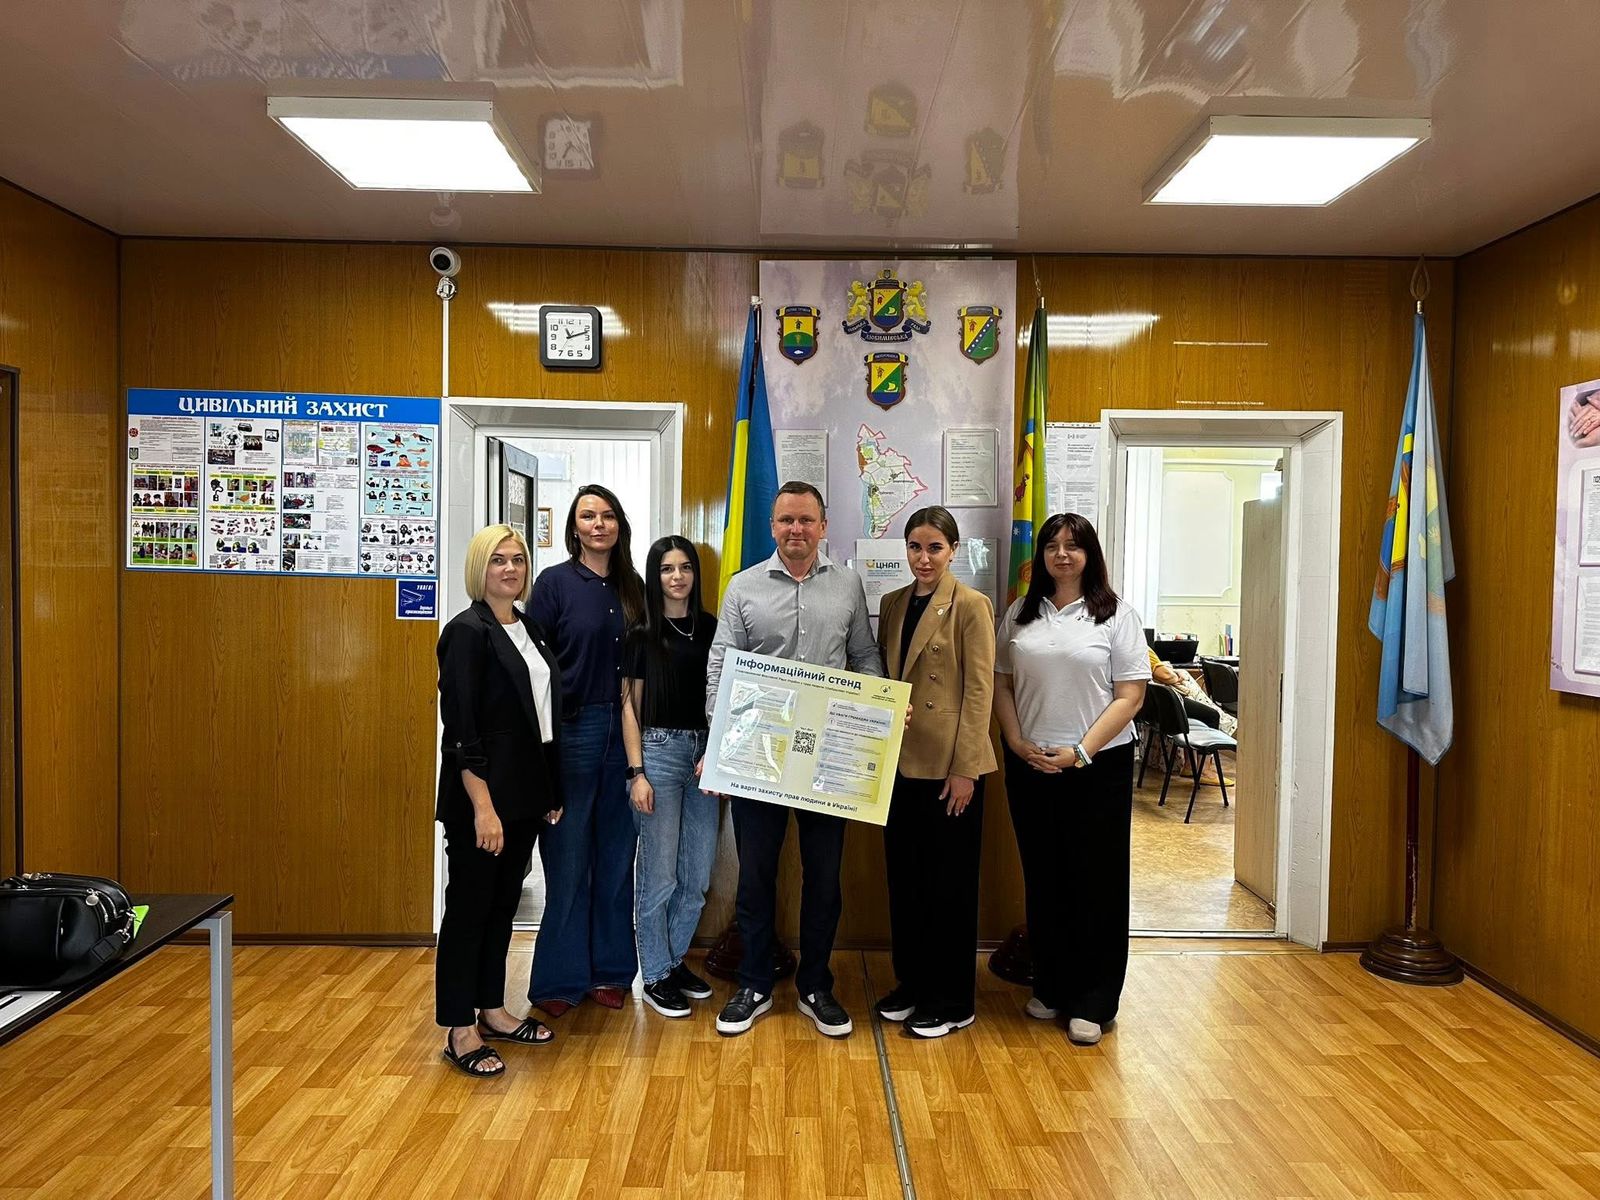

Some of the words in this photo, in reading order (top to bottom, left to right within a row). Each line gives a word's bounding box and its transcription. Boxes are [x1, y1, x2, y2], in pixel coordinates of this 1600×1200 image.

[178, 396, 298, 414] ЦИВІЛЬНИЙ
[306, 400, 388, 418] ЗАХИСТ
[736, 656, 826, 682] Інформаційний
[828, 676, 862, 690] стенд
[741, 784, 757, 792] варті
[758, 788, 783, 797] захисту
[800, 796, 826, 806] людини
[832, 802, 858, 812] Україні!
